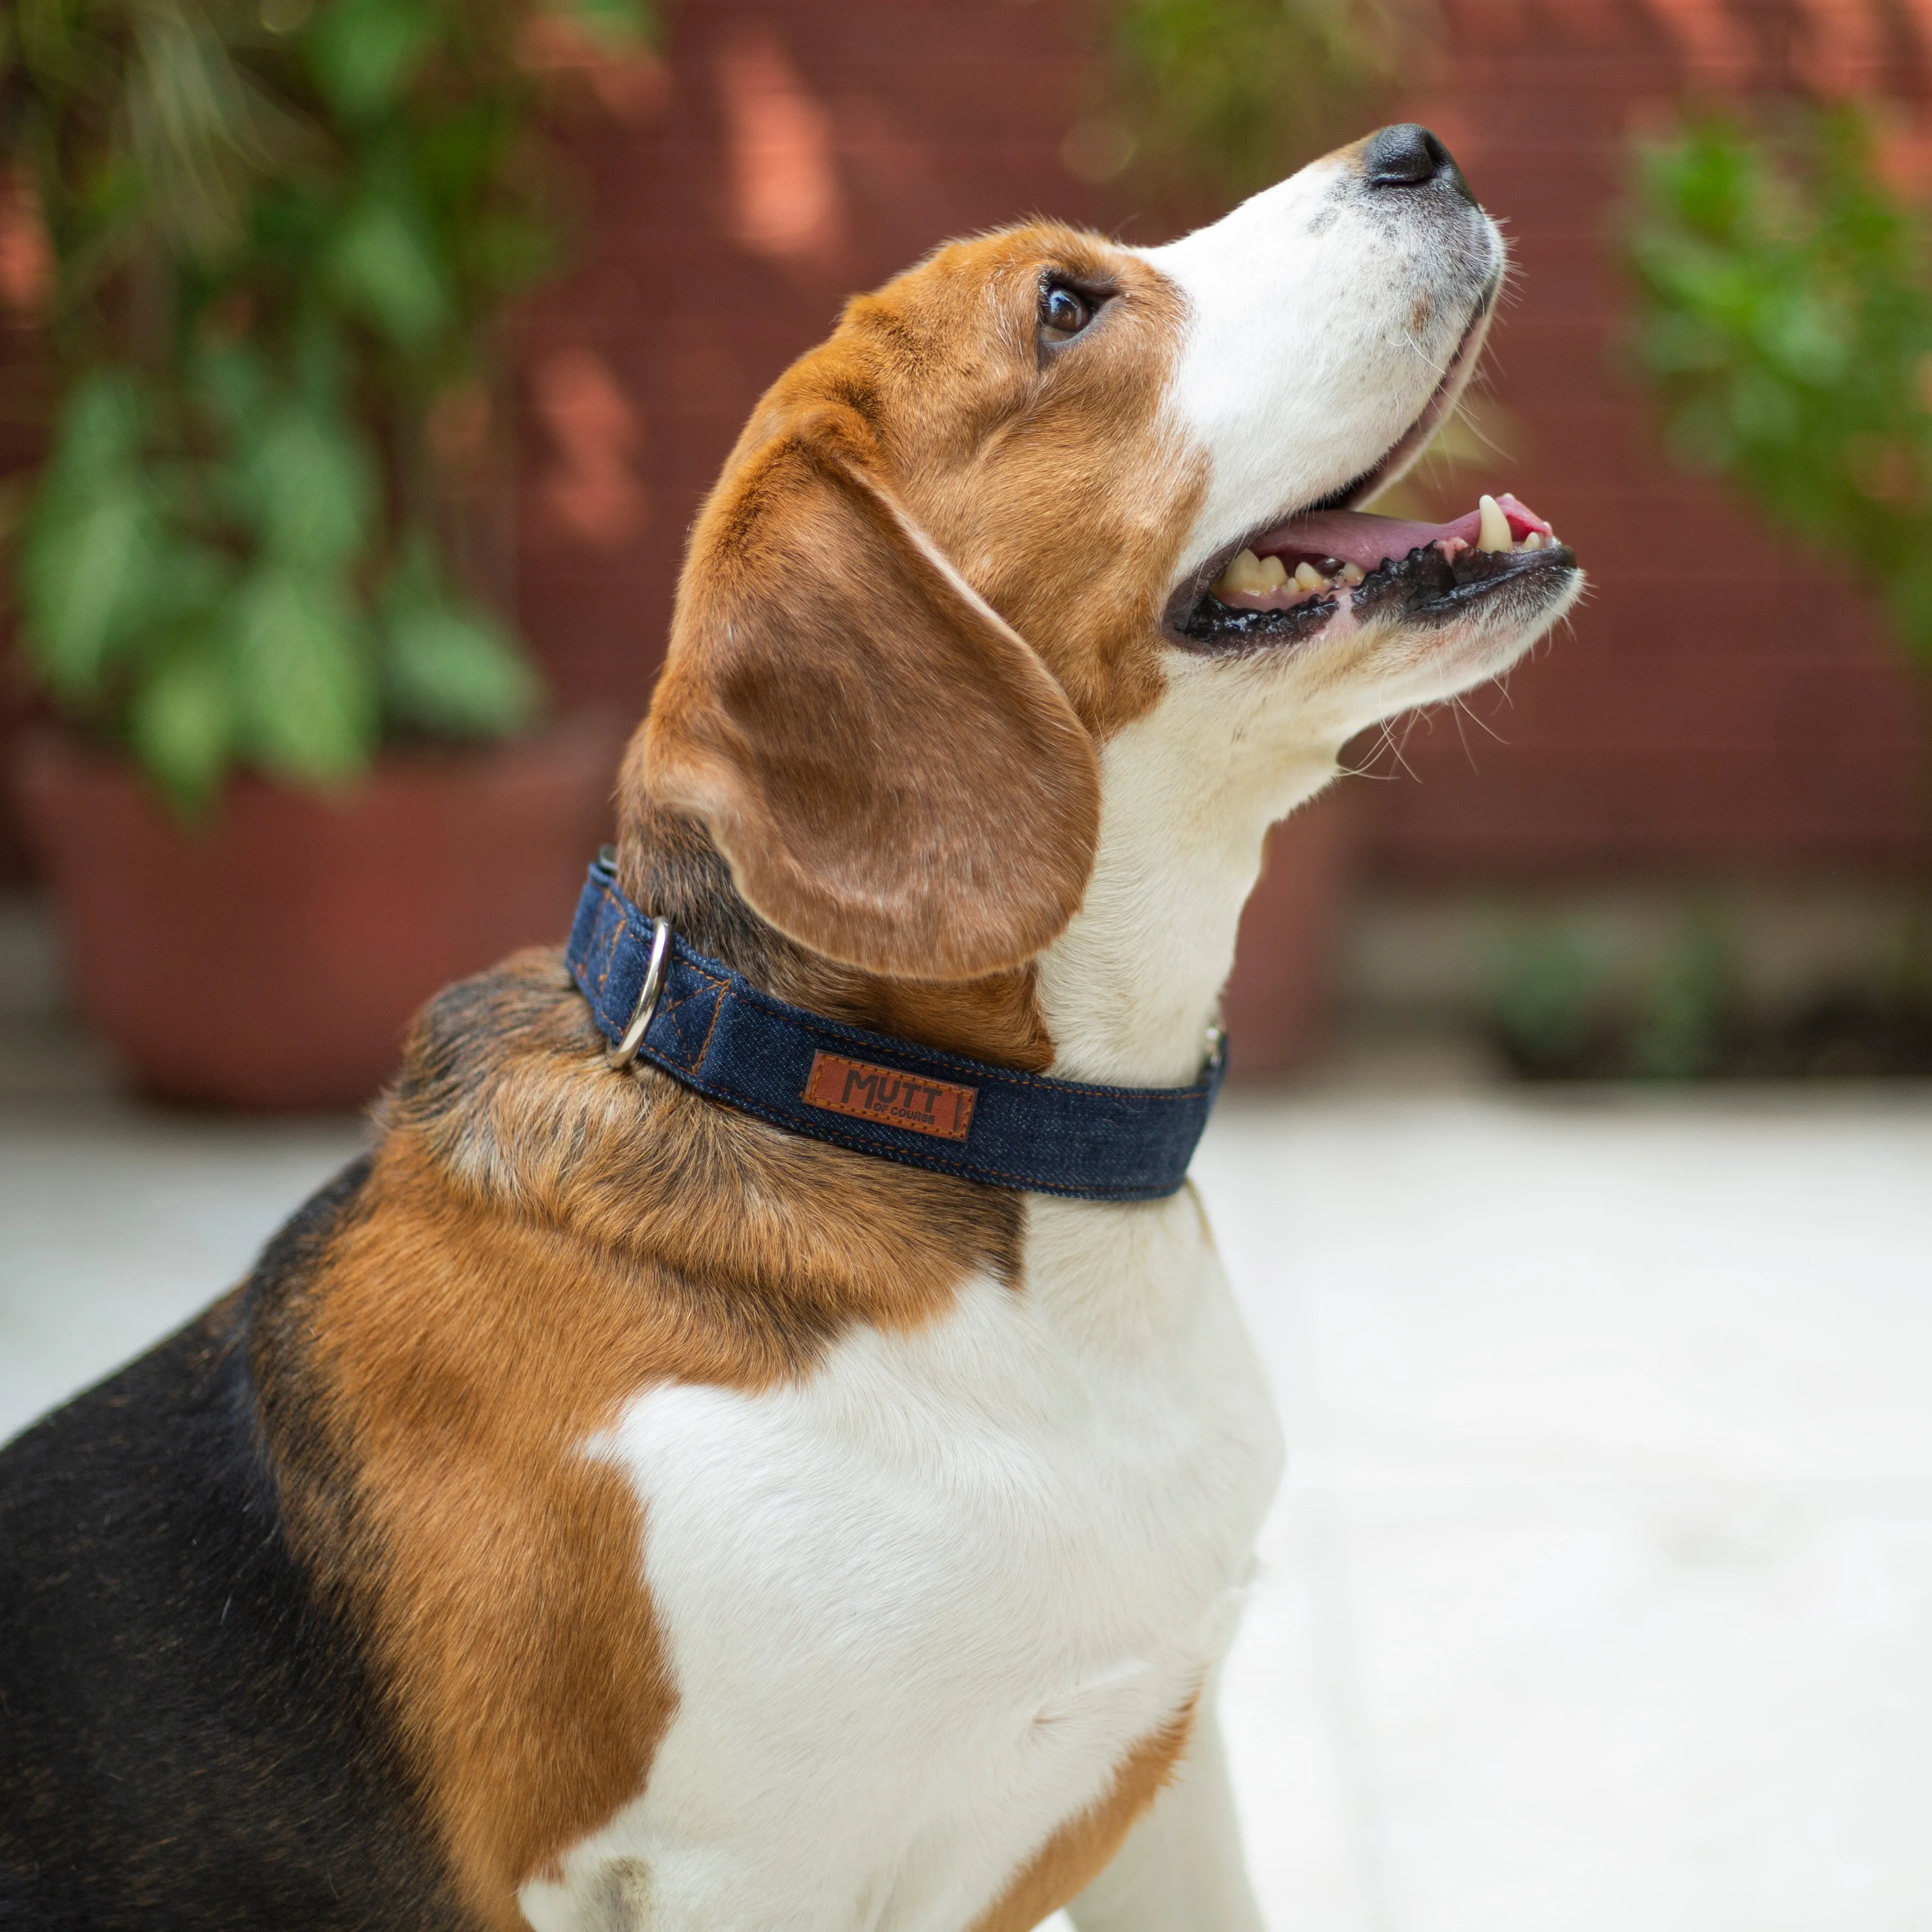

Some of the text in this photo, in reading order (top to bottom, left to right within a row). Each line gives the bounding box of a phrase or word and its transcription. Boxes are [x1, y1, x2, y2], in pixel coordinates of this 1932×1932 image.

[841, 1069, 942, 1113] MUTT
[873, 1102, 936, 1124] OF COURSE
